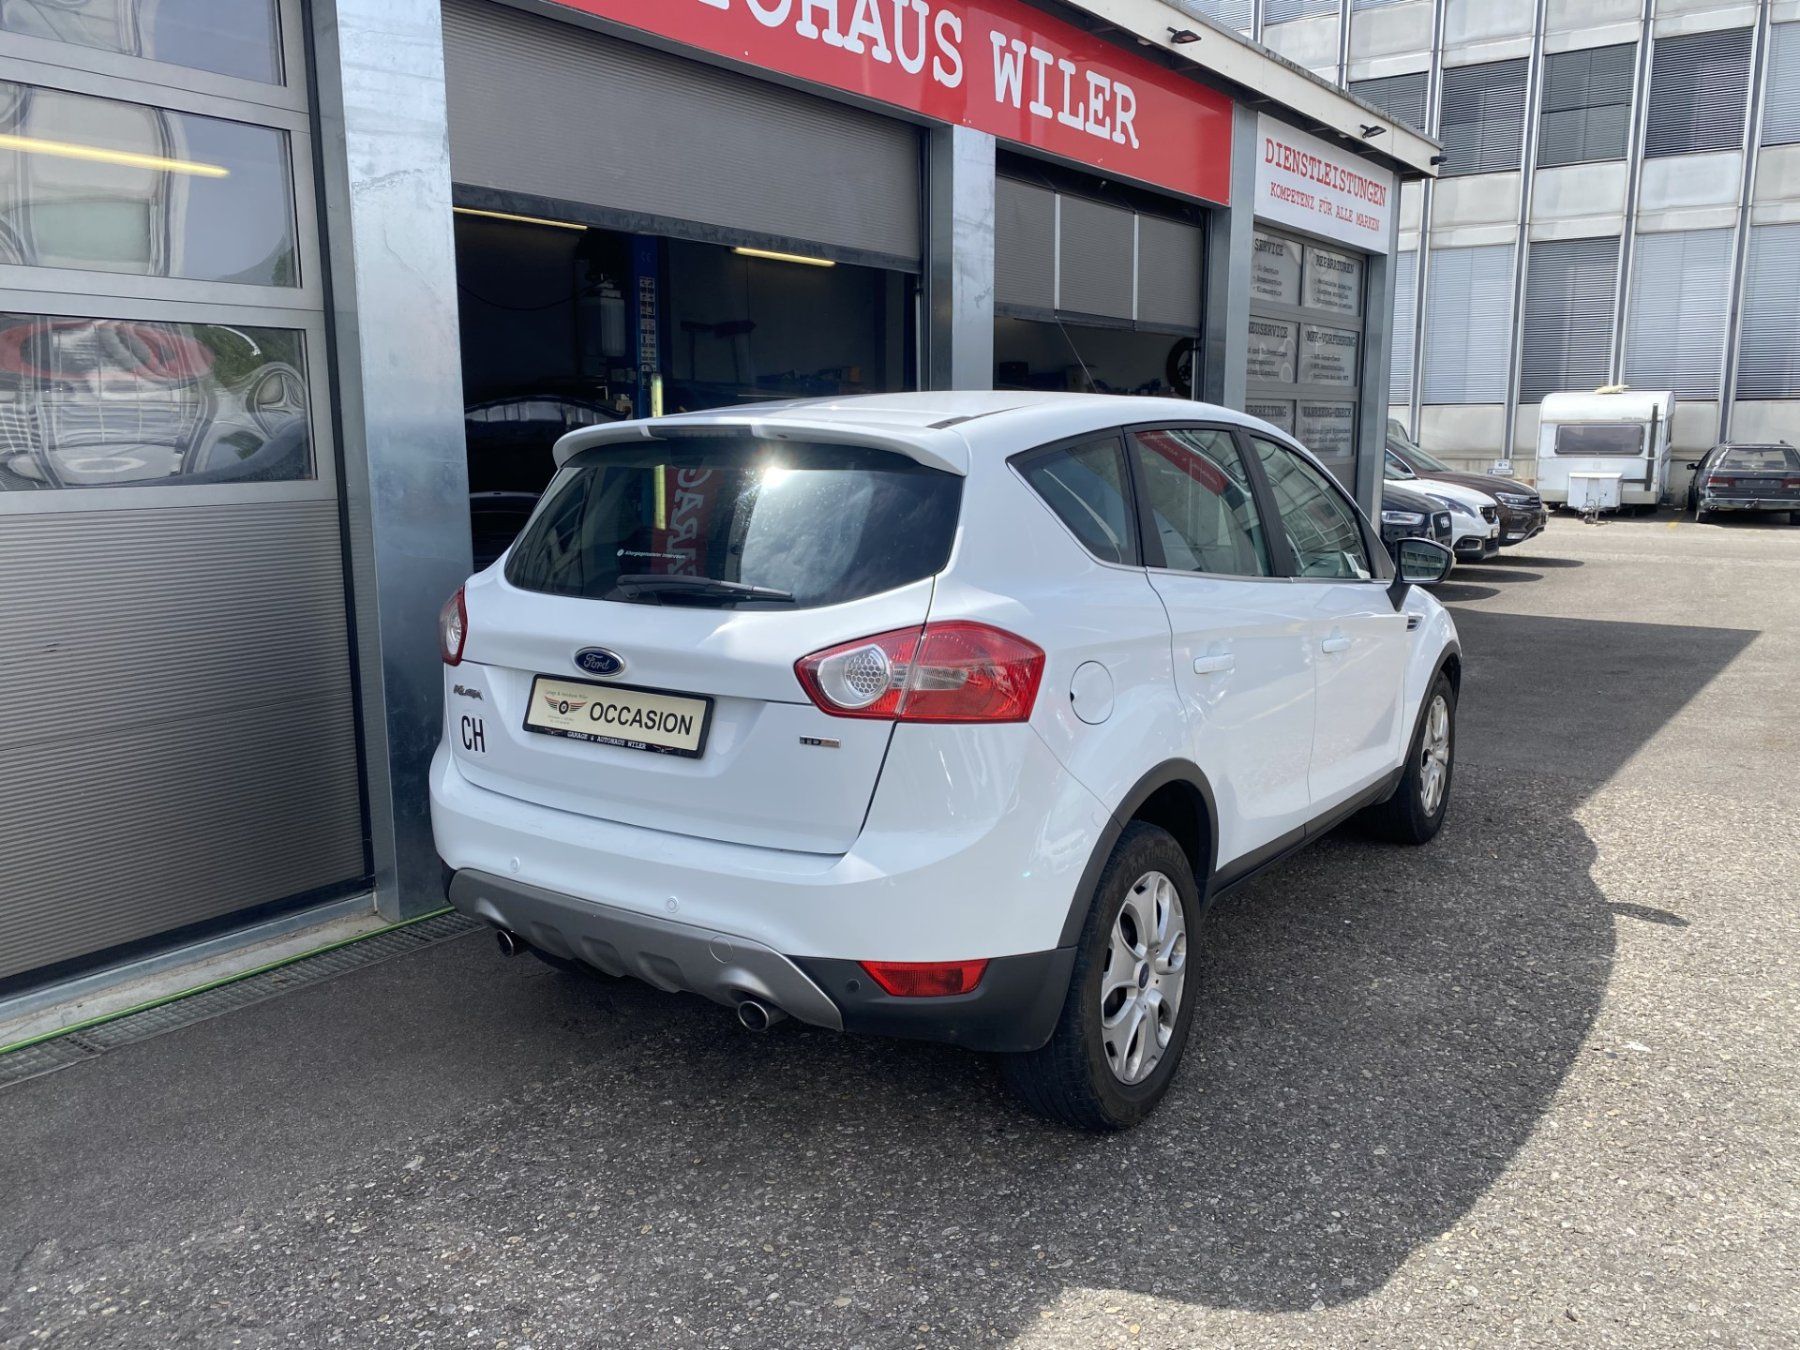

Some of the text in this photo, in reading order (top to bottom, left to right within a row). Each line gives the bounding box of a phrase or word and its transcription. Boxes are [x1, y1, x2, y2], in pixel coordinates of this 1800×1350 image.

[989, 31, 1140, 149] WILER
[1264, 138, 1387, 208] DIENSTLEISTUNGEN
[1270, 182, 1380, 231] KOMPETENZ FÜR ALLE MARKEN
[1255, 238, 1284, 257] SERVICE
[583, 653, 611, 671] Ford
[461, 715, 486, 753] CH
[589, 701, 693, 736] OCCASION
[567, 731, 588, 741] GARAGE
[596, 736, 625, 747] AUTOHAUS
[627, 741, 647, 750] WILER
